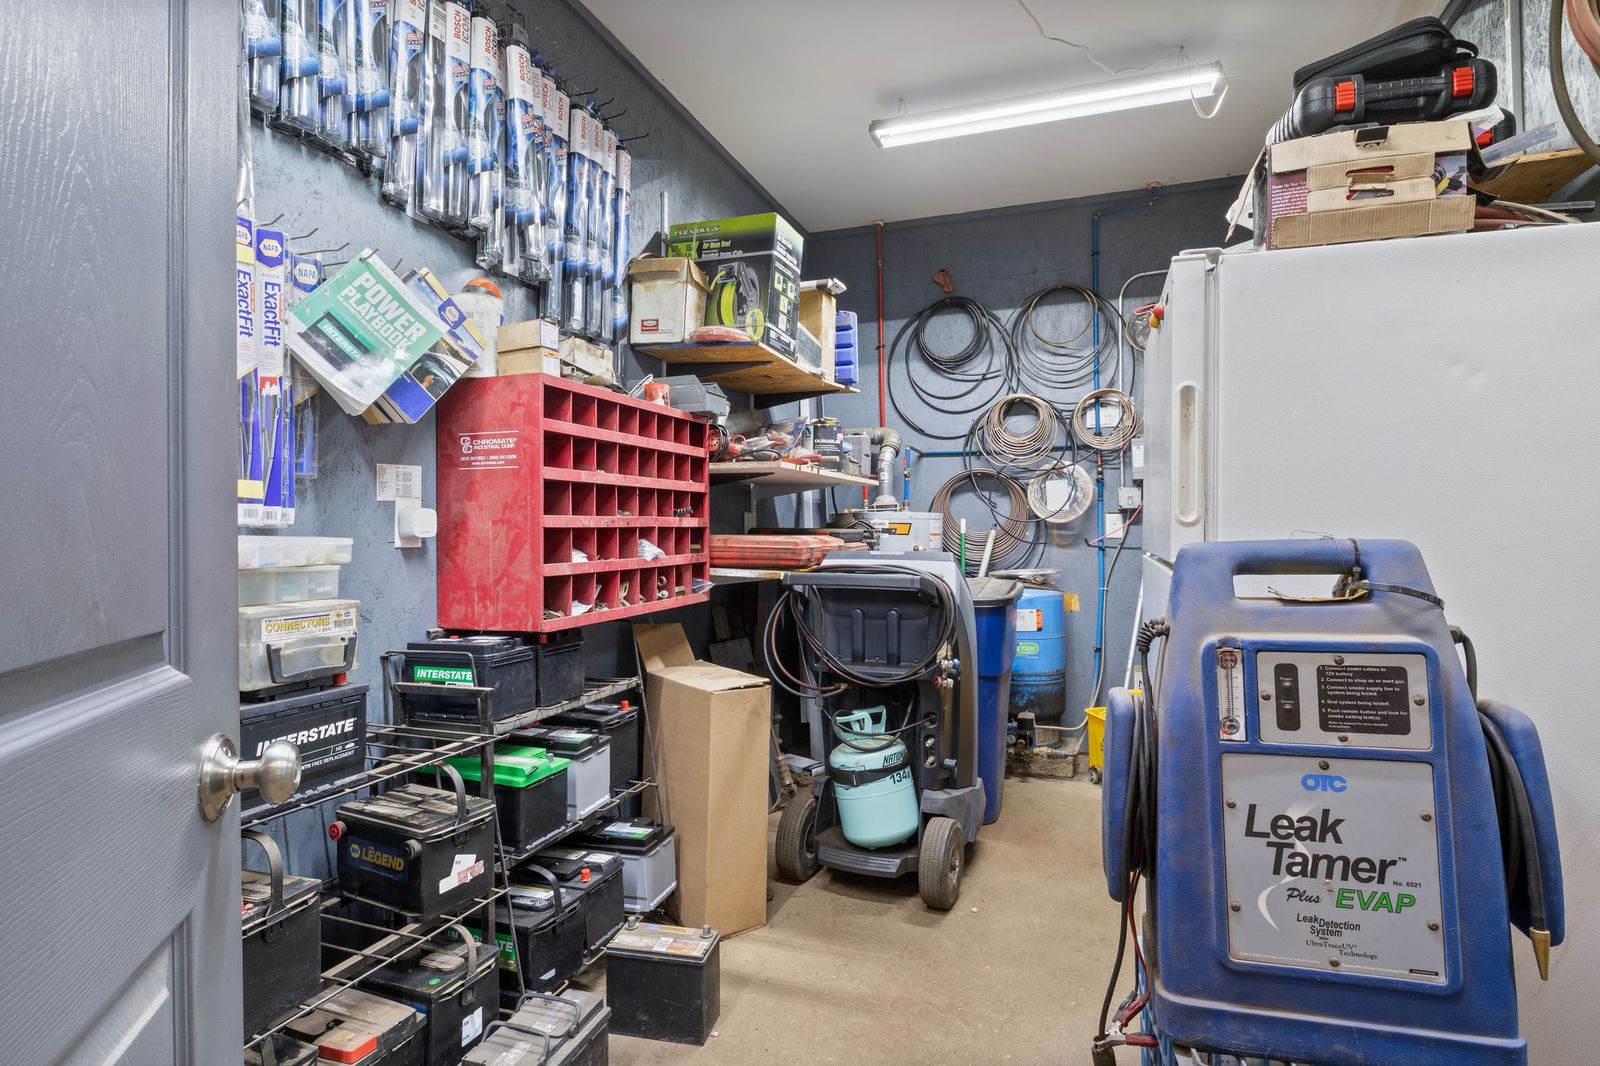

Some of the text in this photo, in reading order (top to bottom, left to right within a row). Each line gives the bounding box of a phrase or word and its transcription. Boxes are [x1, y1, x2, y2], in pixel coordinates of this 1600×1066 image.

[453, 10, 462, 40] BOSCH
[462, 14, 470, 45] ICON
[484, 26, 492, 54] BOSCH
[518, 52, 526, 82] BOSCH
[531, 72, 540, 99] ICON
[237, 230, 249, 241] APA
[262, 242, 280, 254] NAPA
[298, 267, 317, 280] NAPA
[237, 268, 254, 338] ExactFit
[264, 281, 282, 347] ExactFit
[352, 271, 428, 342] POWER
[340, 284, 414, 354] PLAYBOOK
[472, 438, 515, 446] CHROMATE
[264, 617, 330, 634] CONNECTORS
[416, 669, 473, 680] INTERSTATE
[312, 759, 323, 767] FREE
[323, 750, 356, 764] REPLACEMENT
[1301, 774, 1347, 793] OTC
[1244, 803, 1345, 844] Leak
[361, 847, 405, 871] LEGEND
[1266, 841, 1397, 885] Tamer
[1285, 887, 1417, 914] Plus EVAP
[1296, 912, 1361, 931] Leak Detection
[1309, 925, 1343, 937] System
[1338, 949, 1378, 960] Technology
